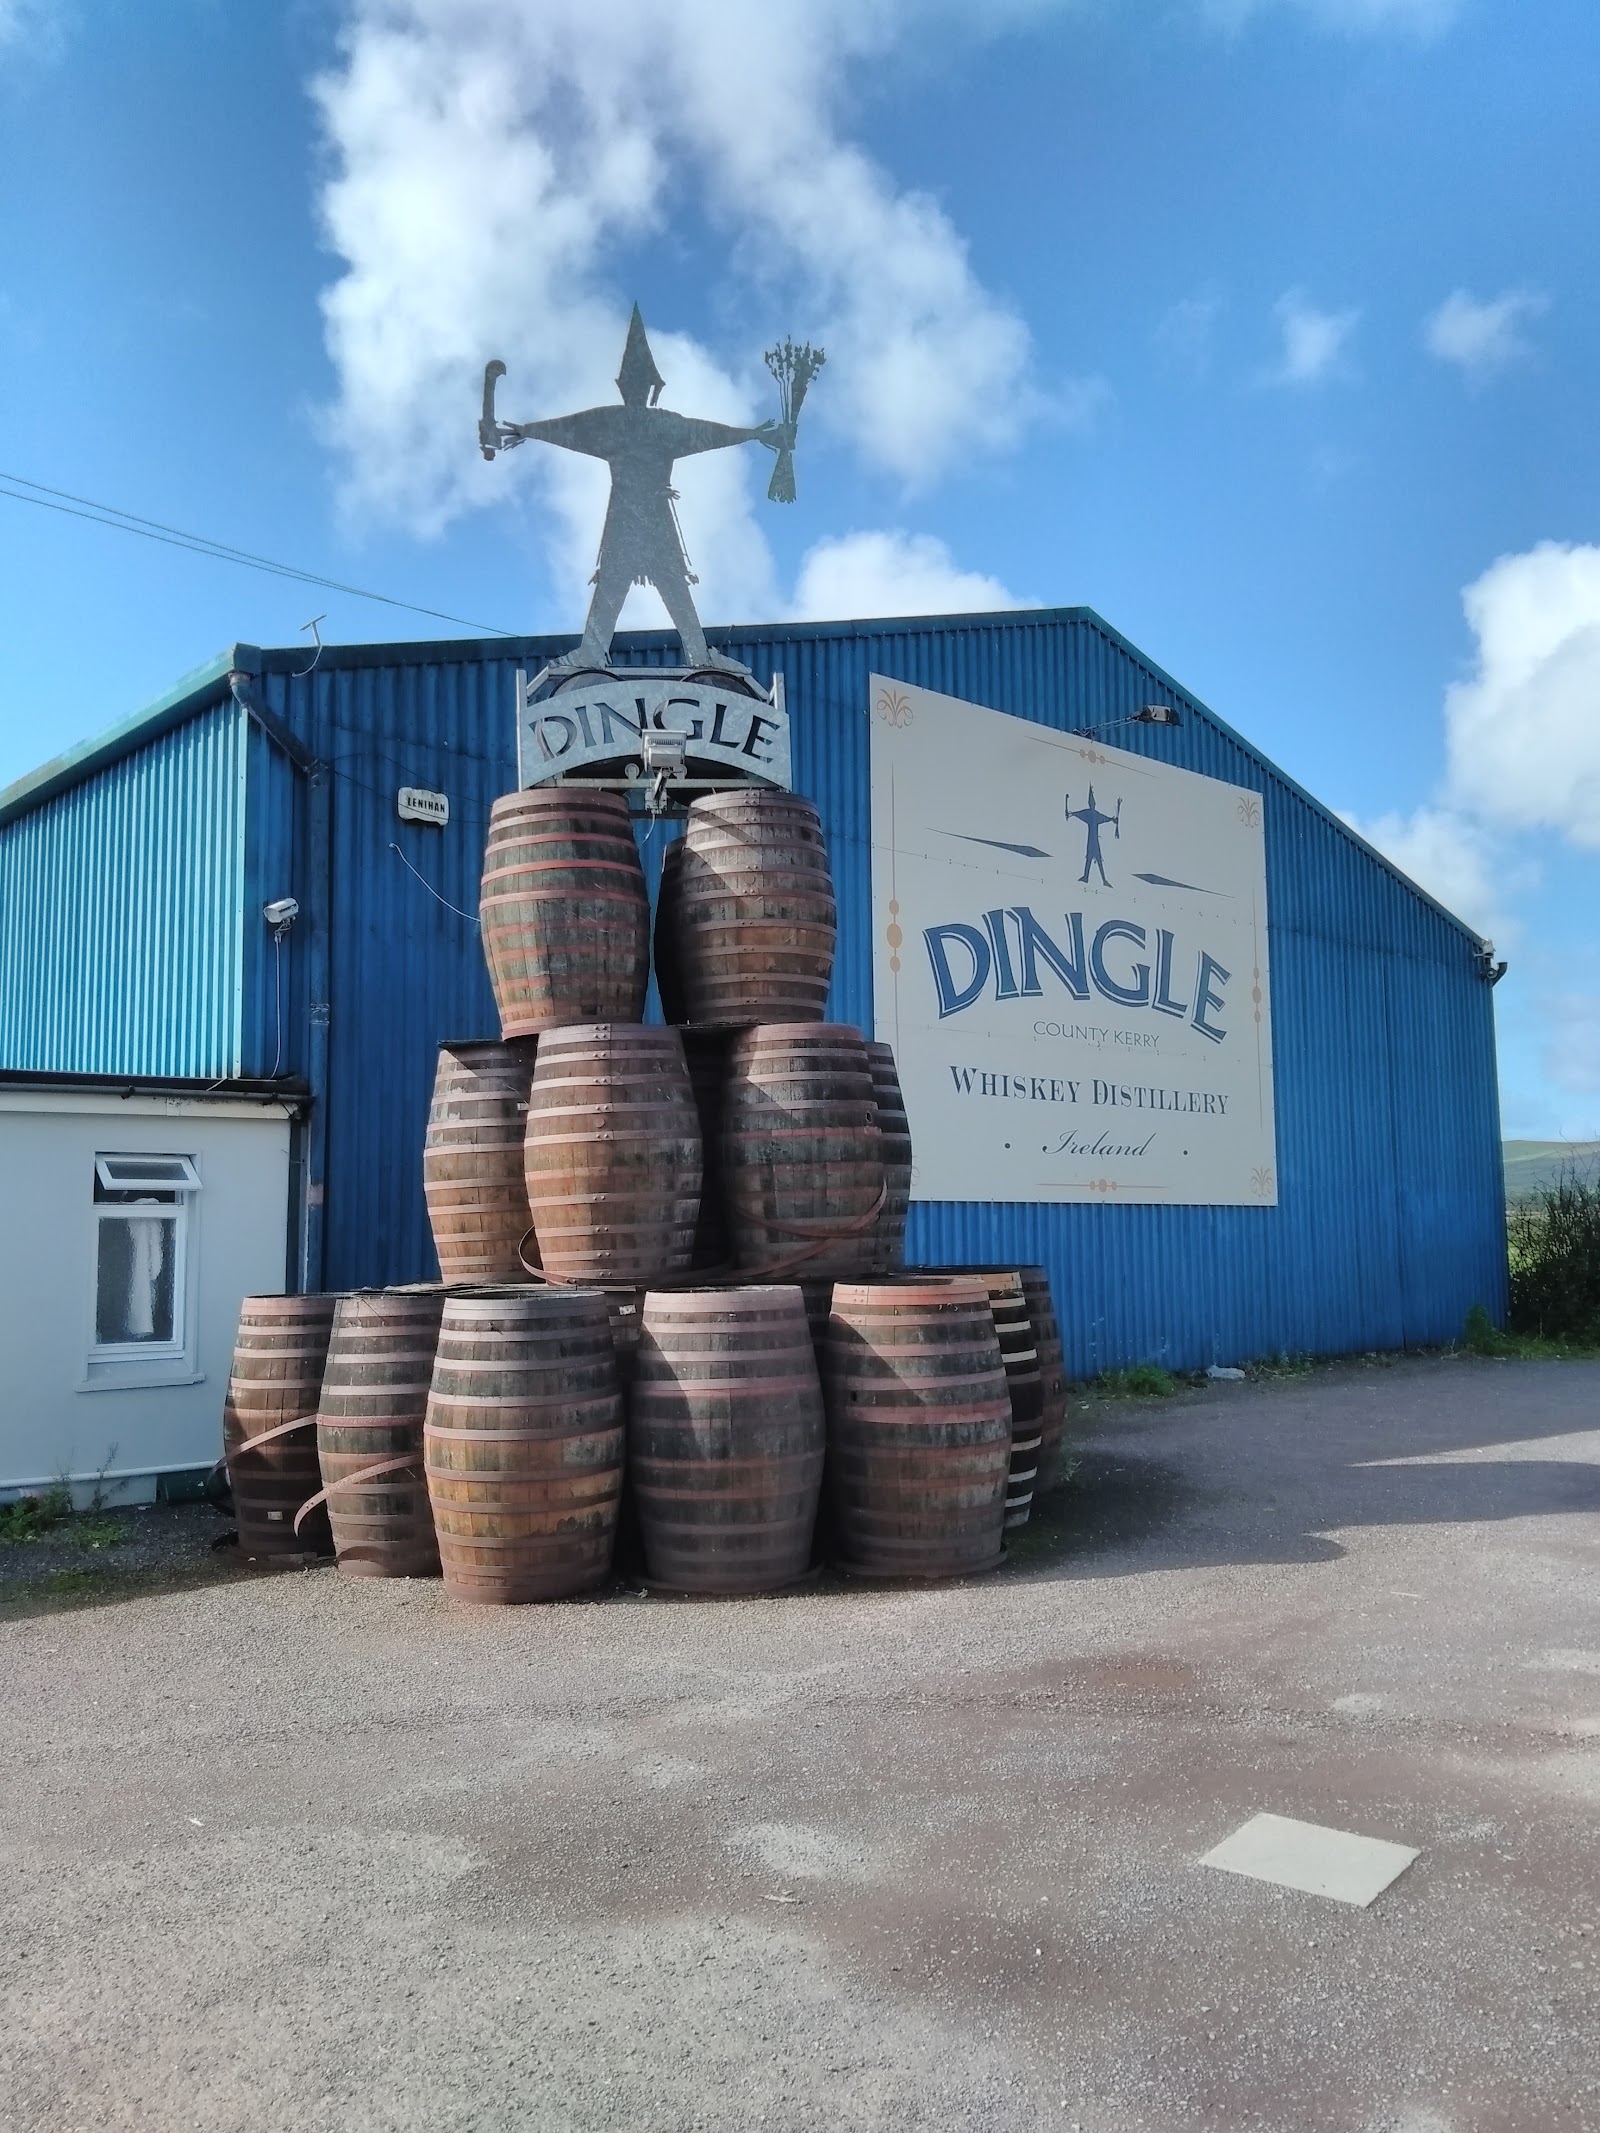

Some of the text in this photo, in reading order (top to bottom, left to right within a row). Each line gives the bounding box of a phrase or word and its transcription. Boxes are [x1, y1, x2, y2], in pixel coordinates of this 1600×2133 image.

[528, 698, 781, 764] DINGLE
[407, 797, 445, 813] LENIHAN
[923, 906, 1232, 1044] DINGLE
[1033, 1020, 1160, 1048] COUNTY KERRY
[1041, 1130, 1157, 1158] Ireland
